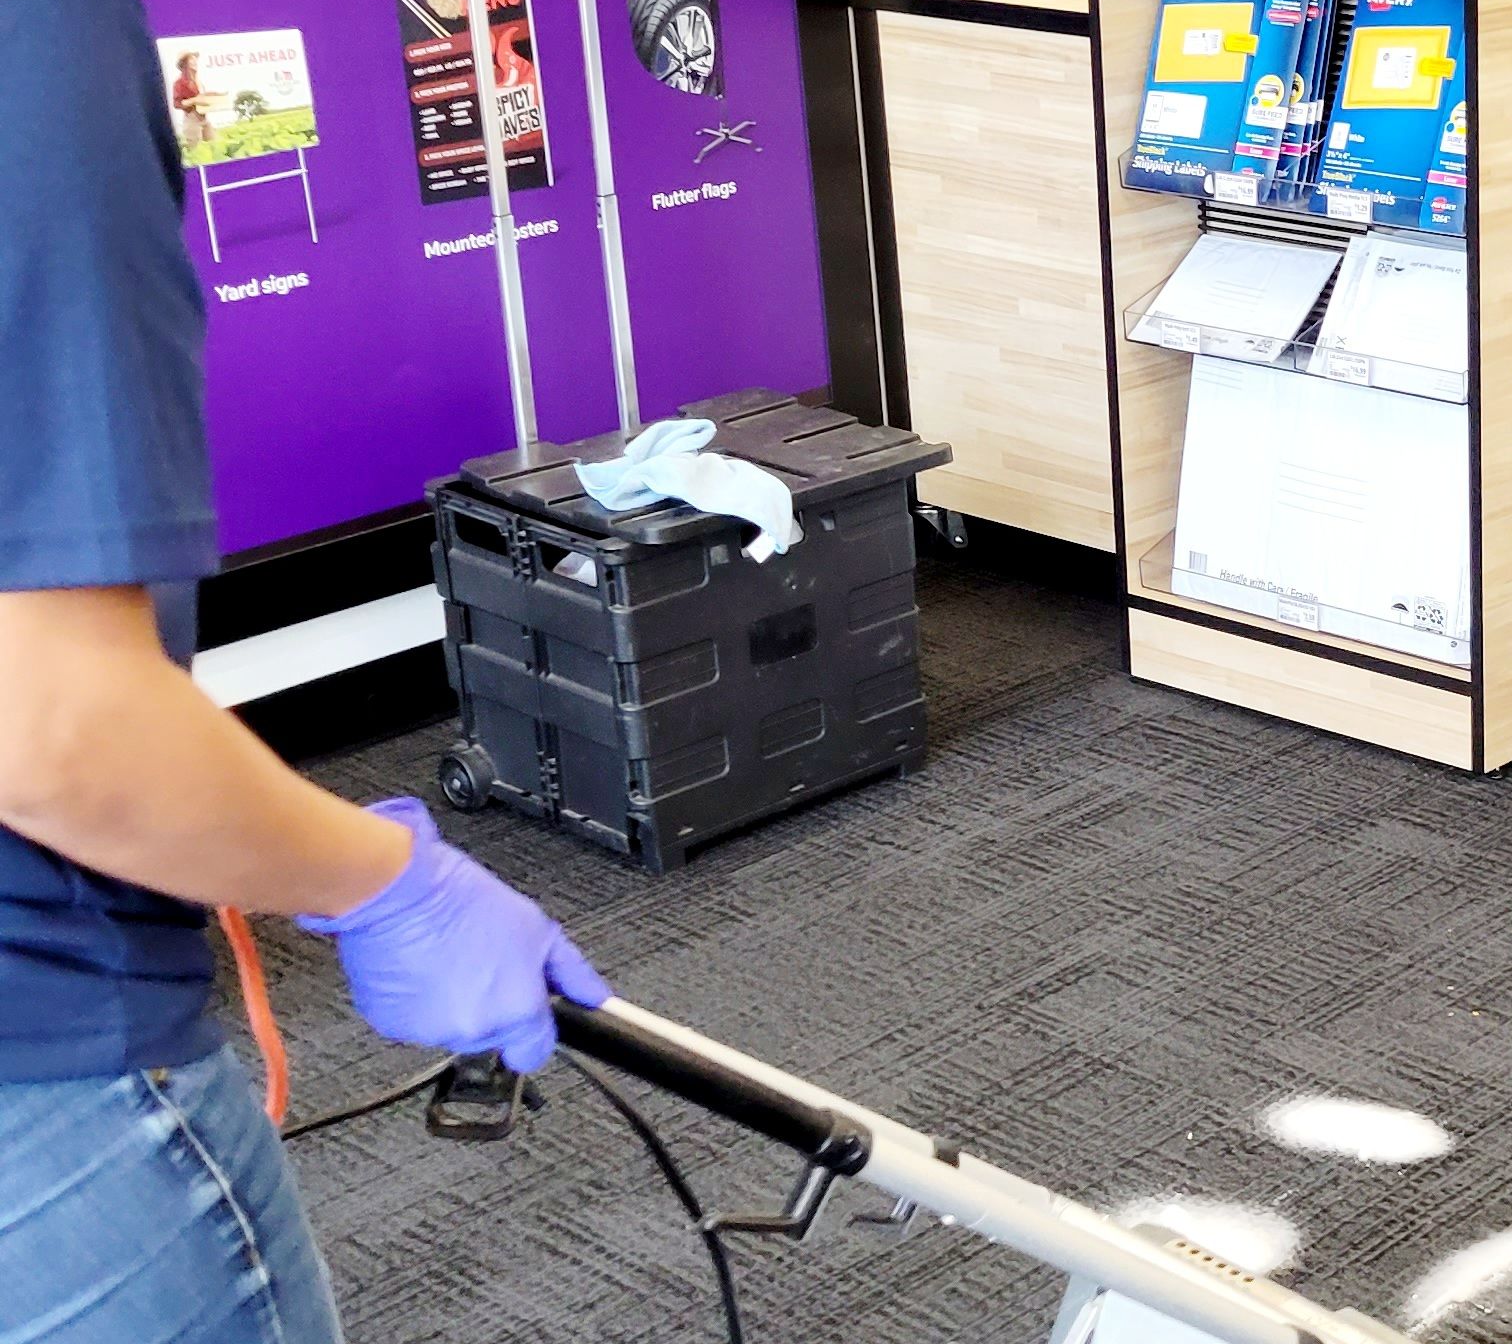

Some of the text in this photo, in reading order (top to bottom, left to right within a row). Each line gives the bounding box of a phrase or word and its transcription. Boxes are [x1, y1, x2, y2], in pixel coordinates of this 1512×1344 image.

[206, 48, 297, 69] JUST AHEAD
[652, 180, 737, 211] Flutter flags
[424, 219, 560, 259] Mounted osters
[214, 272, 310, 304] Yard signs
[1219, 568, 1248, 586] Handle
